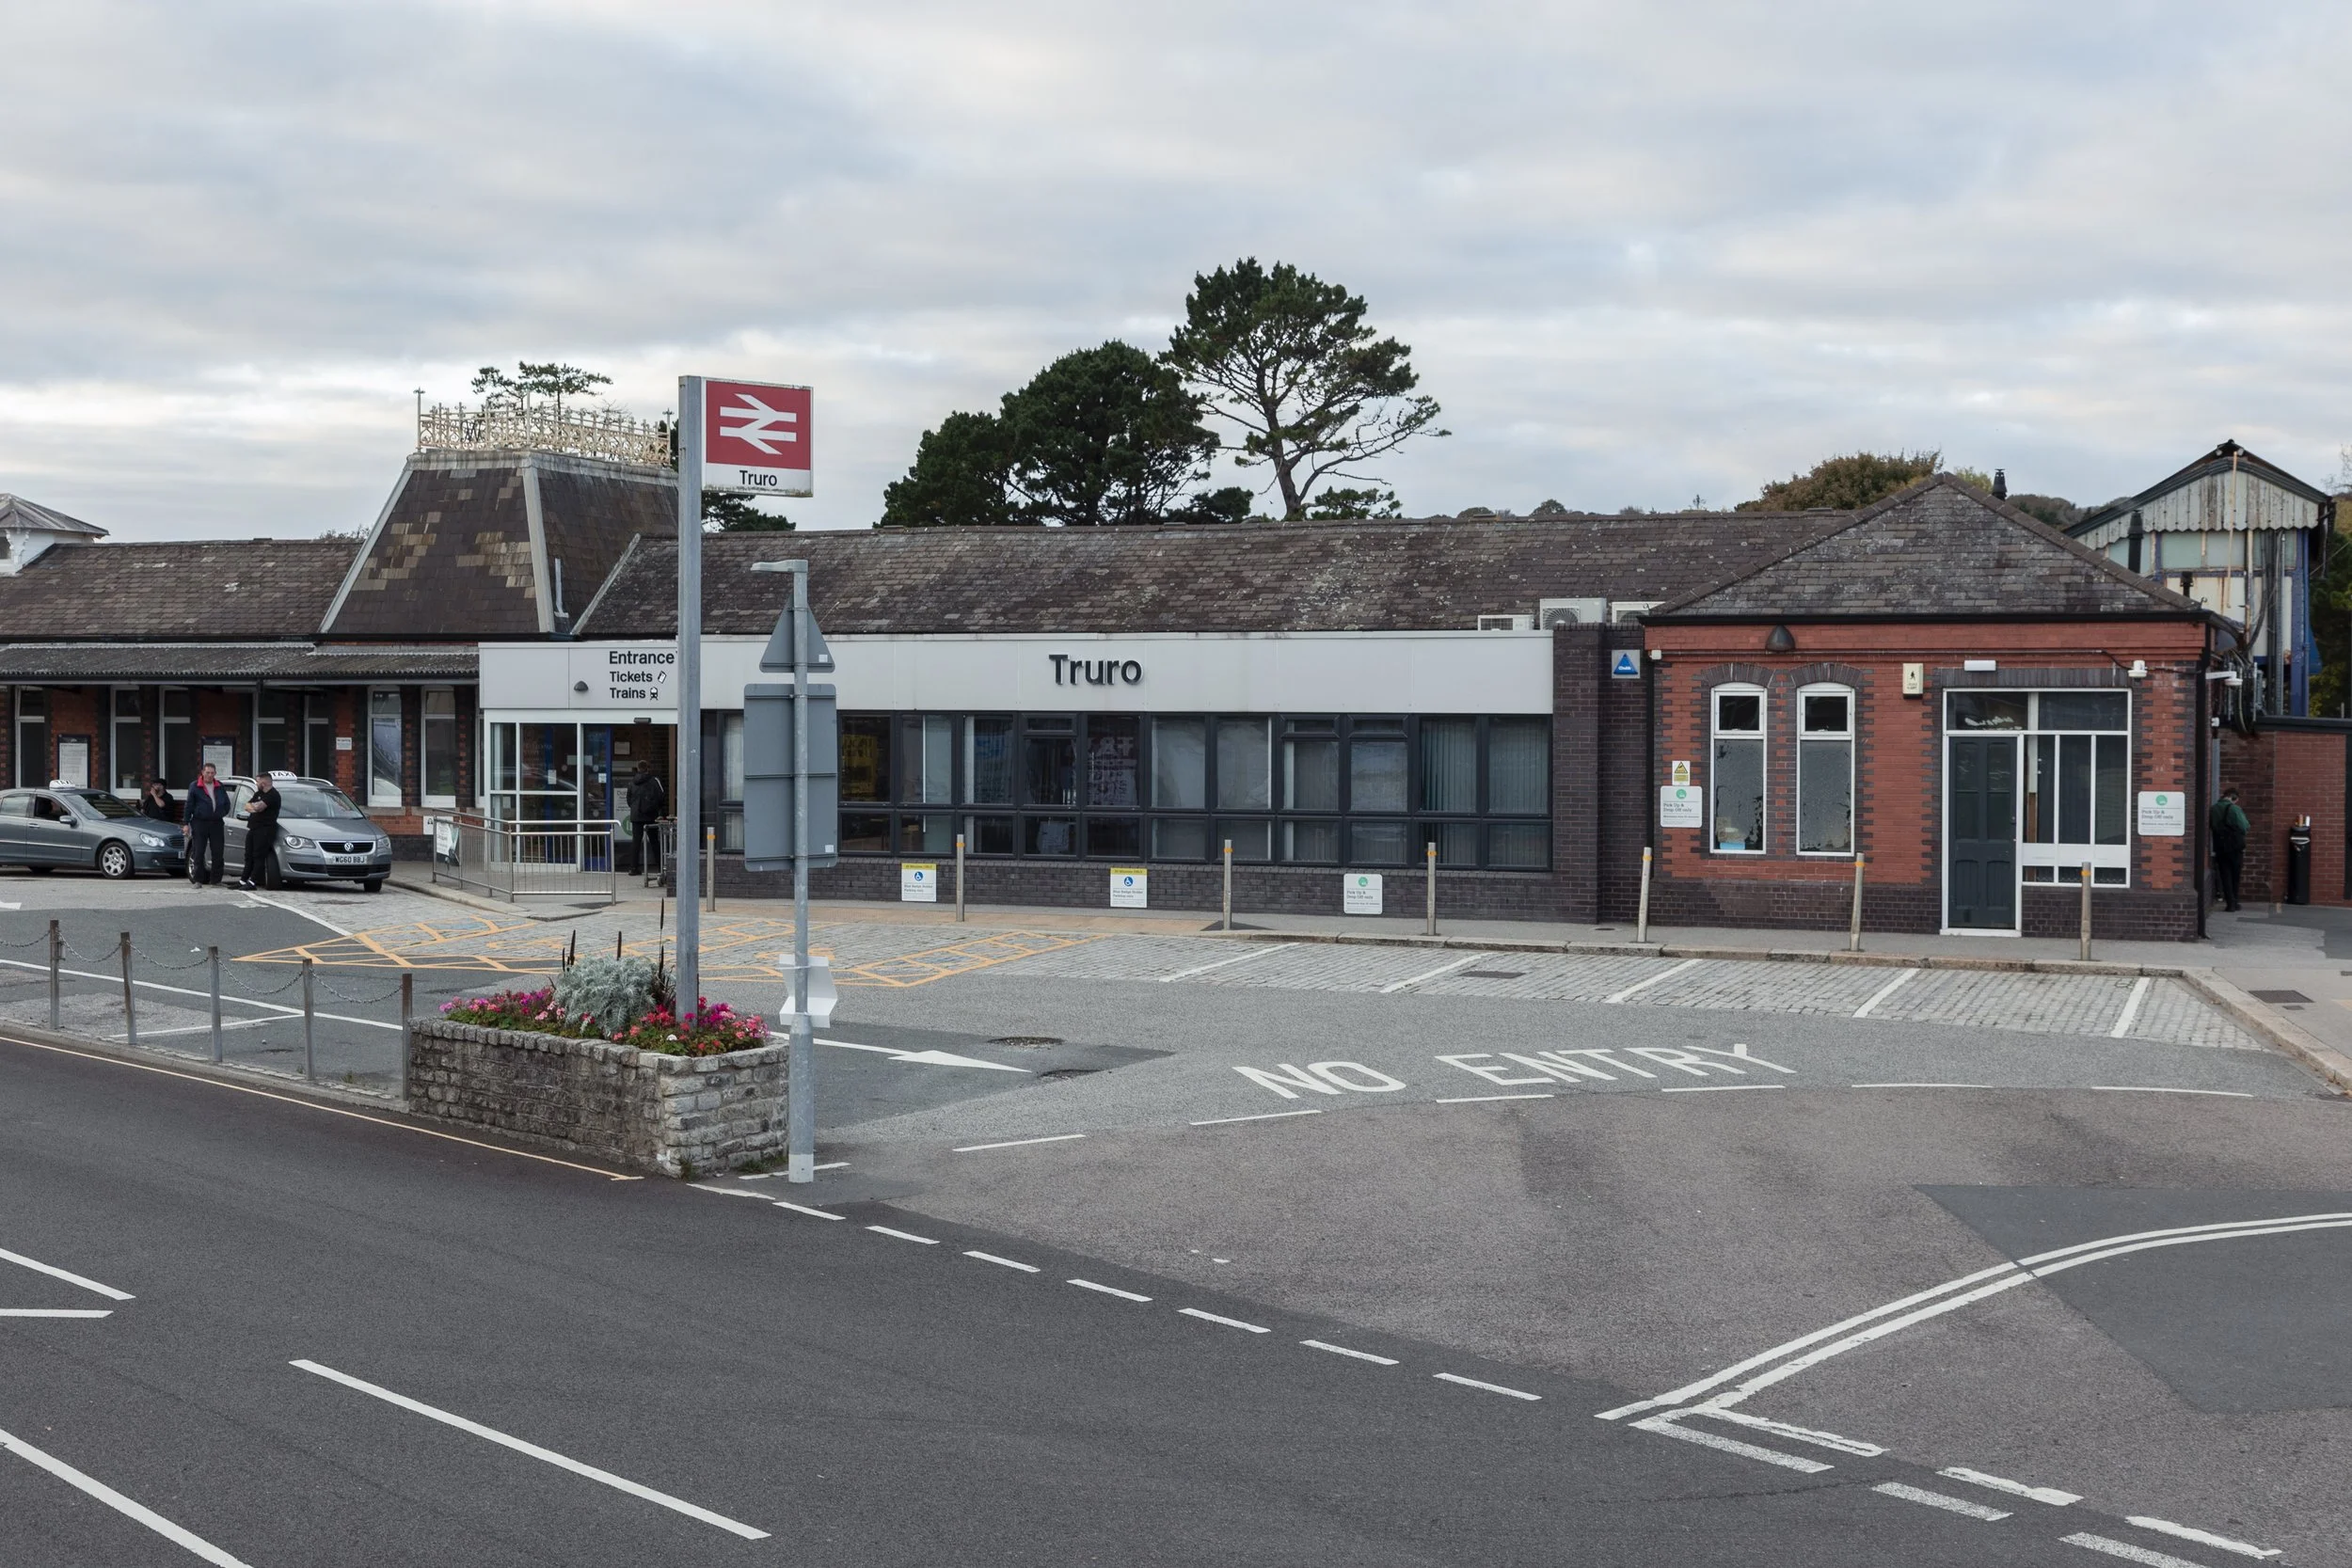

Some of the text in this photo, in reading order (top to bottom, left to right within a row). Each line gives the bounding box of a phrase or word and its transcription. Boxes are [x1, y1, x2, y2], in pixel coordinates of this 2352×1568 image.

[739, 470, 777, 486] Truro
[609, 651, 675, 664] Entrance
[610, 671, 653, 682] Tickets
[1049, 655, 1142, 685] Truro
[610, 688, 645, 699] Trains
[1232, 1044, 1797, 1099] NO ENTRY
